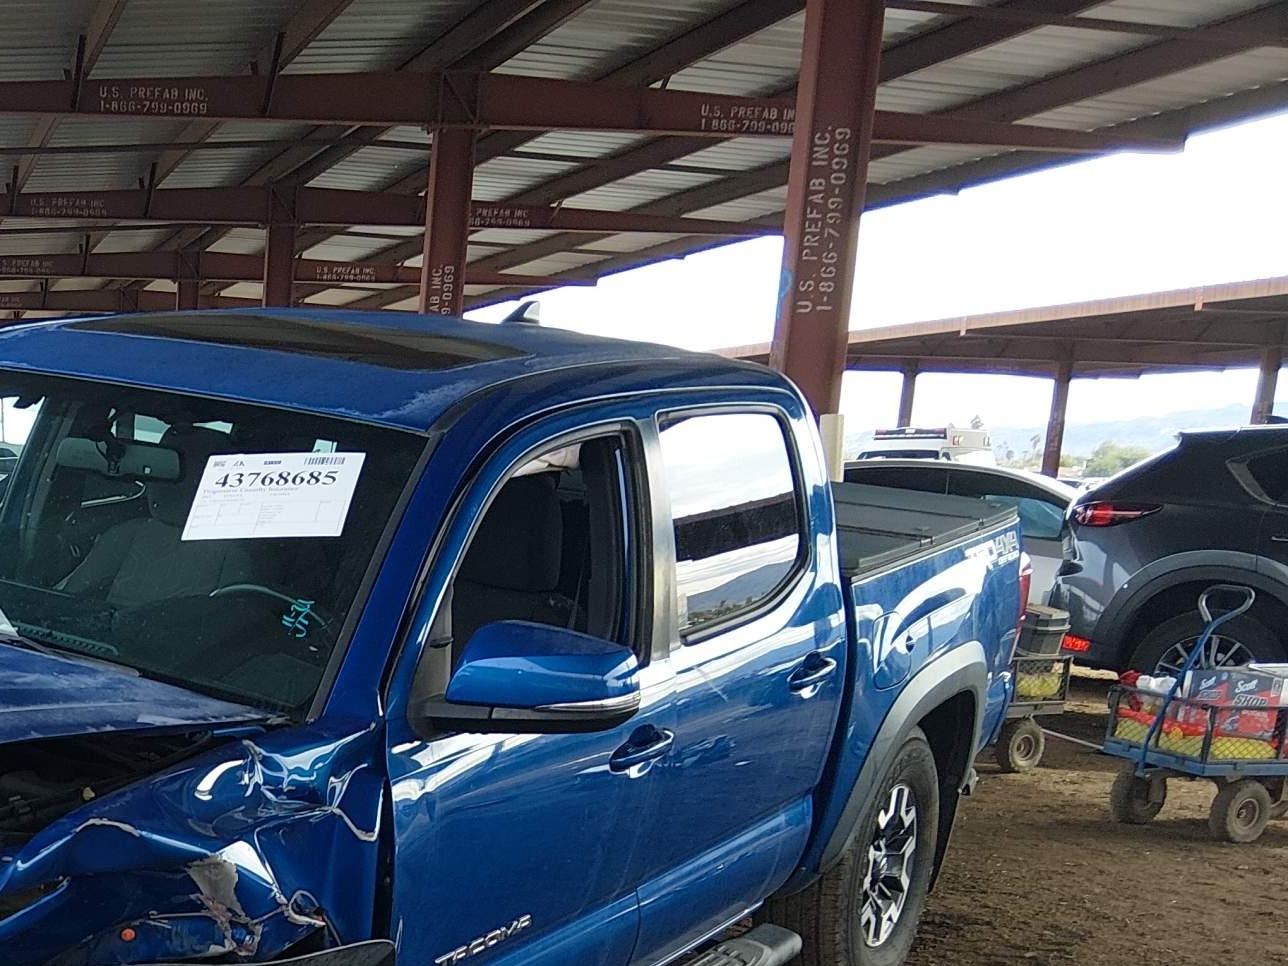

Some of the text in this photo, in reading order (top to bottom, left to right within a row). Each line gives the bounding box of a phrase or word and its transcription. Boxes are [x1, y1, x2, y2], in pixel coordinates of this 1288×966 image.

[98, 85, 209, 102] U.S. PREFAB INC.
[99, 100, 208, 114] 1-866-799-0969
[700, 103, 796, 121] U.S. PREFAB IN
[795, 125, 833, 313] U.S. PREFAB INC.
[815, 127, 852, 311] 1-866-799-0969
[215, 470, 340, 489] 43768685
